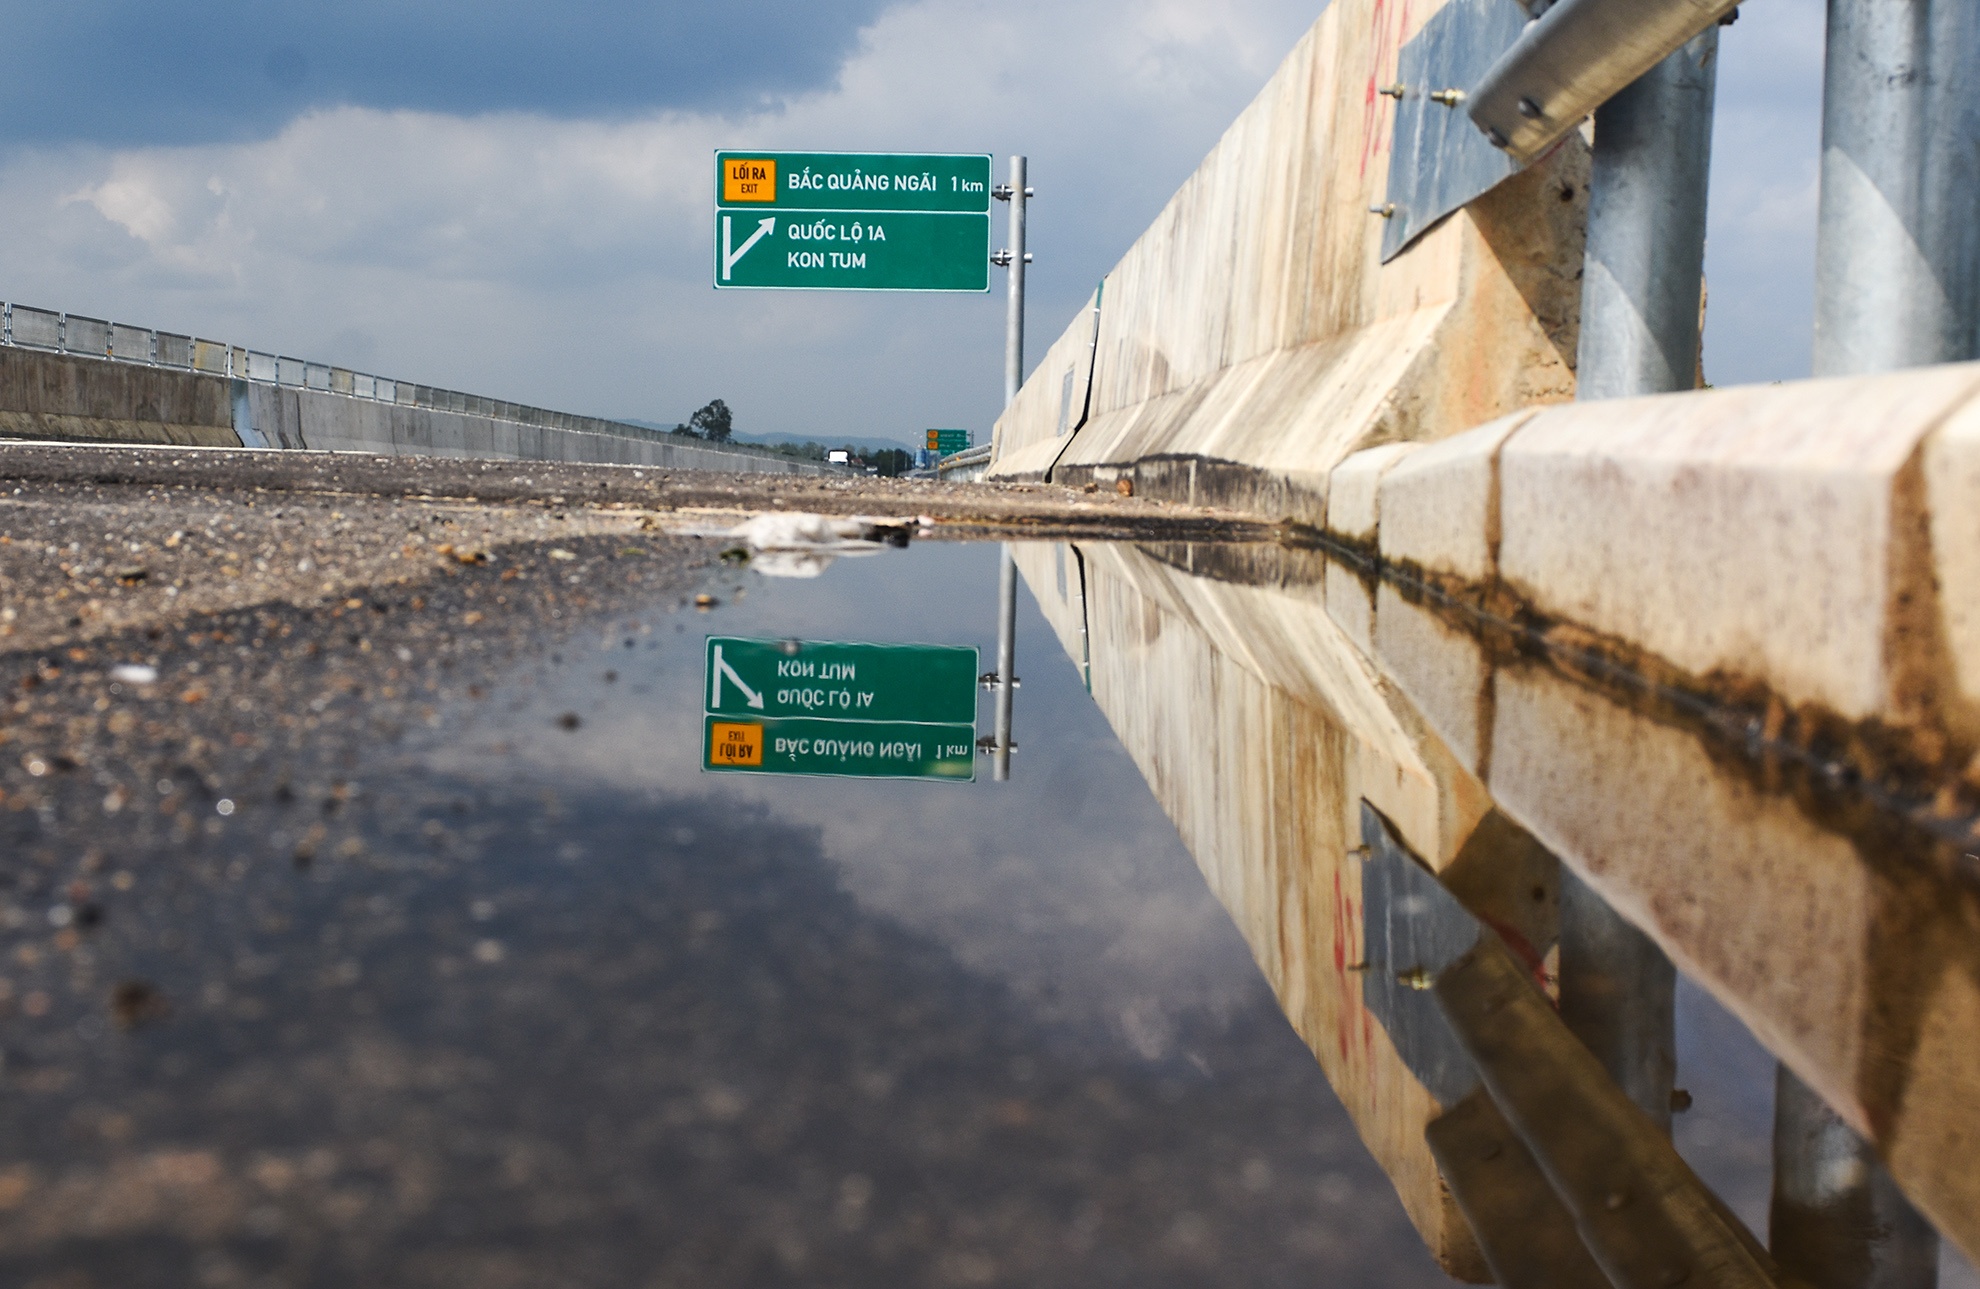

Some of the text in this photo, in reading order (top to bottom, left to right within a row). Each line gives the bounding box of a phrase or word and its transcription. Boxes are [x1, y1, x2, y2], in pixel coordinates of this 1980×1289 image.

[733, 162, 766, 180] LỐI RA
[789, 166, 936, 192] BẮC QUẢNG NGÃI
[741, 184, 758, 194] EXIT
[951, 176, 983, 192] 1 km
[788, 219, 886, 244] QUỐC LỘ 1A
[788, 252, 866, 269] KON TUM
